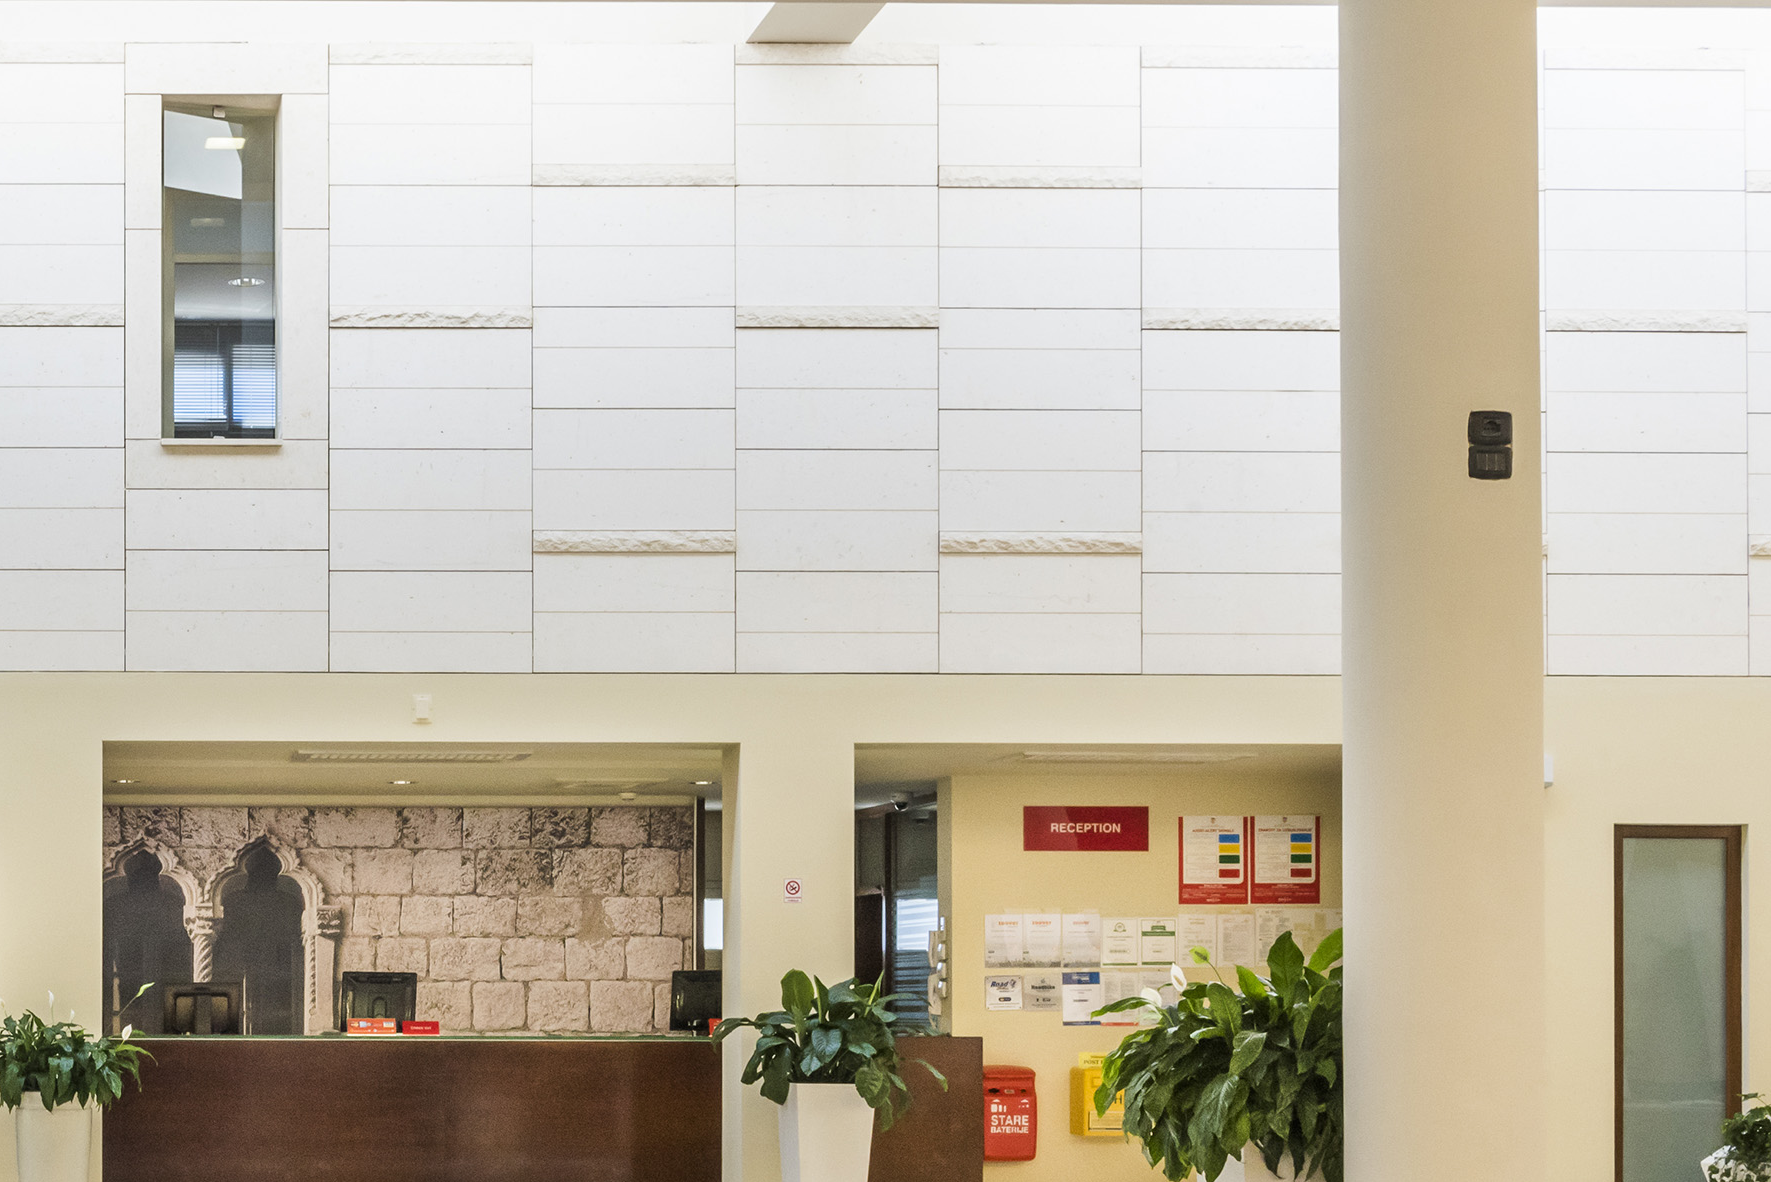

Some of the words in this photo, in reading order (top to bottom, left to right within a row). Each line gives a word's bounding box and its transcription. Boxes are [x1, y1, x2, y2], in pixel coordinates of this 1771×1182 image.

[1050, 822, 1121, 833] RECEPTION
[990, 1114, 1029, 1126] STARE
[990, 1126, 1029, 1134] BATERIJE
